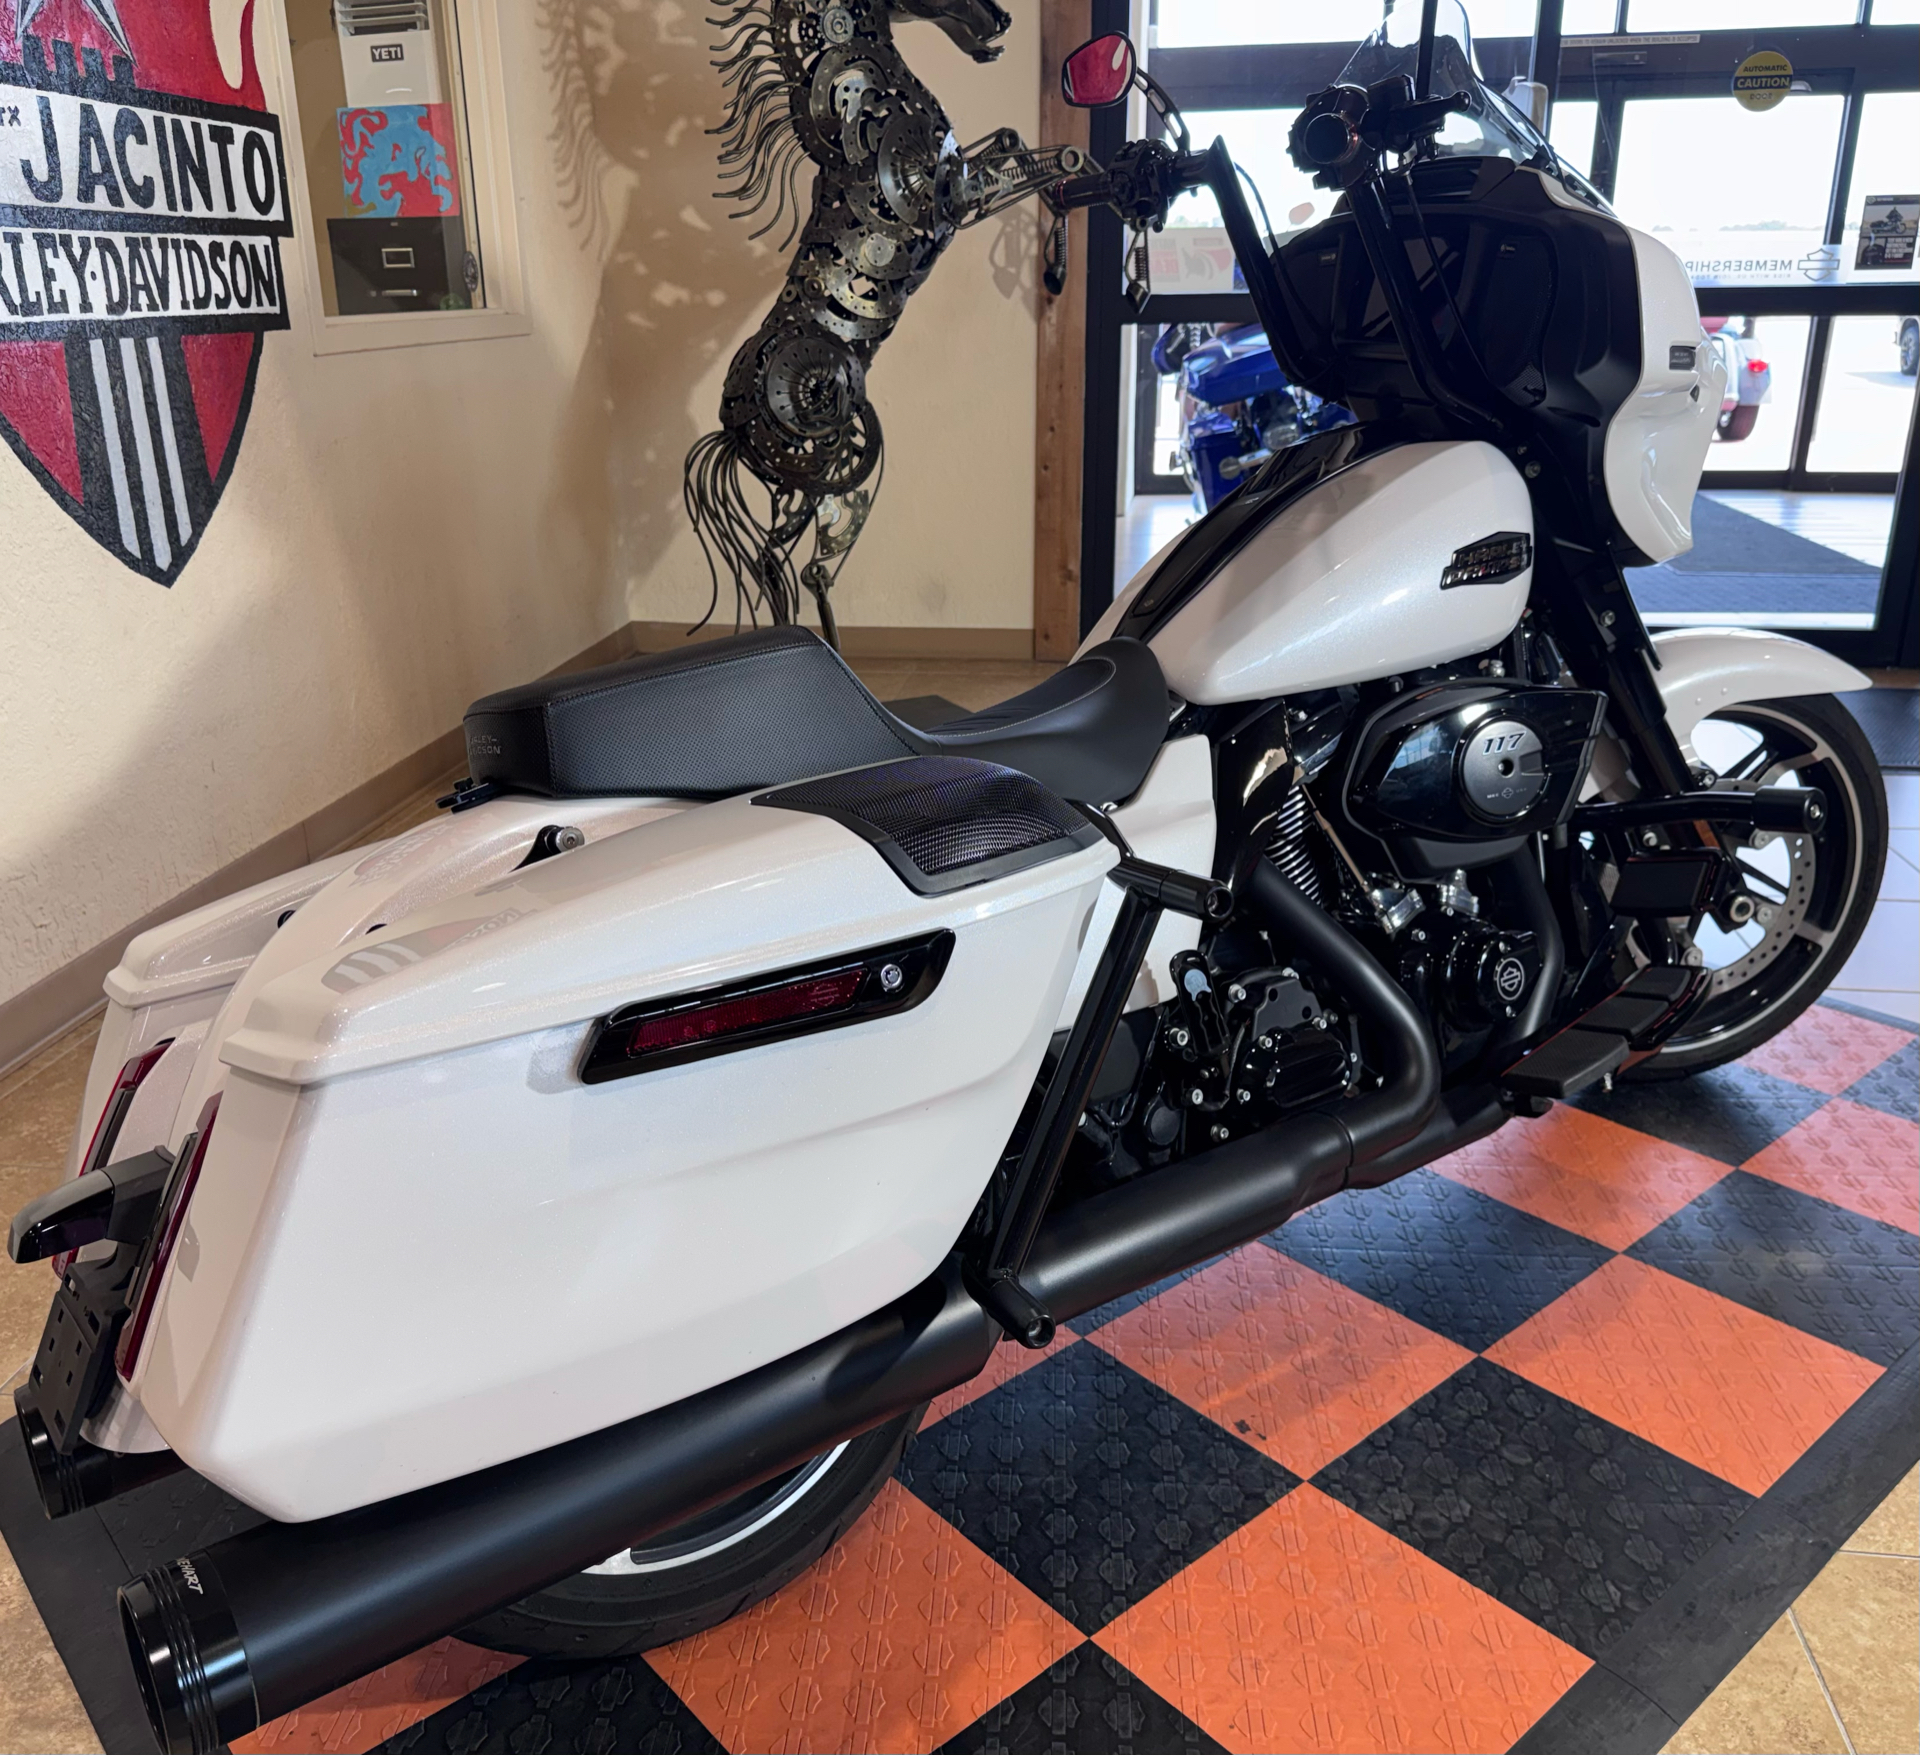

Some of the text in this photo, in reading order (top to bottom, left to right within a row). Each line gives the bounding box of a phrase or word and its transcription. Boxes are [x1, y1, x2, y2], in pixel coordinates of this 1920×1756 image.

[372, 46, 402, 60] YETI
[1743, 64, 1788, 72] AUTOMATIC
[1737, 77, 1790, 88] CAUTION
[19, 95, 275, 216] JACINTO
[1482, 731, 1527, 756] 117
